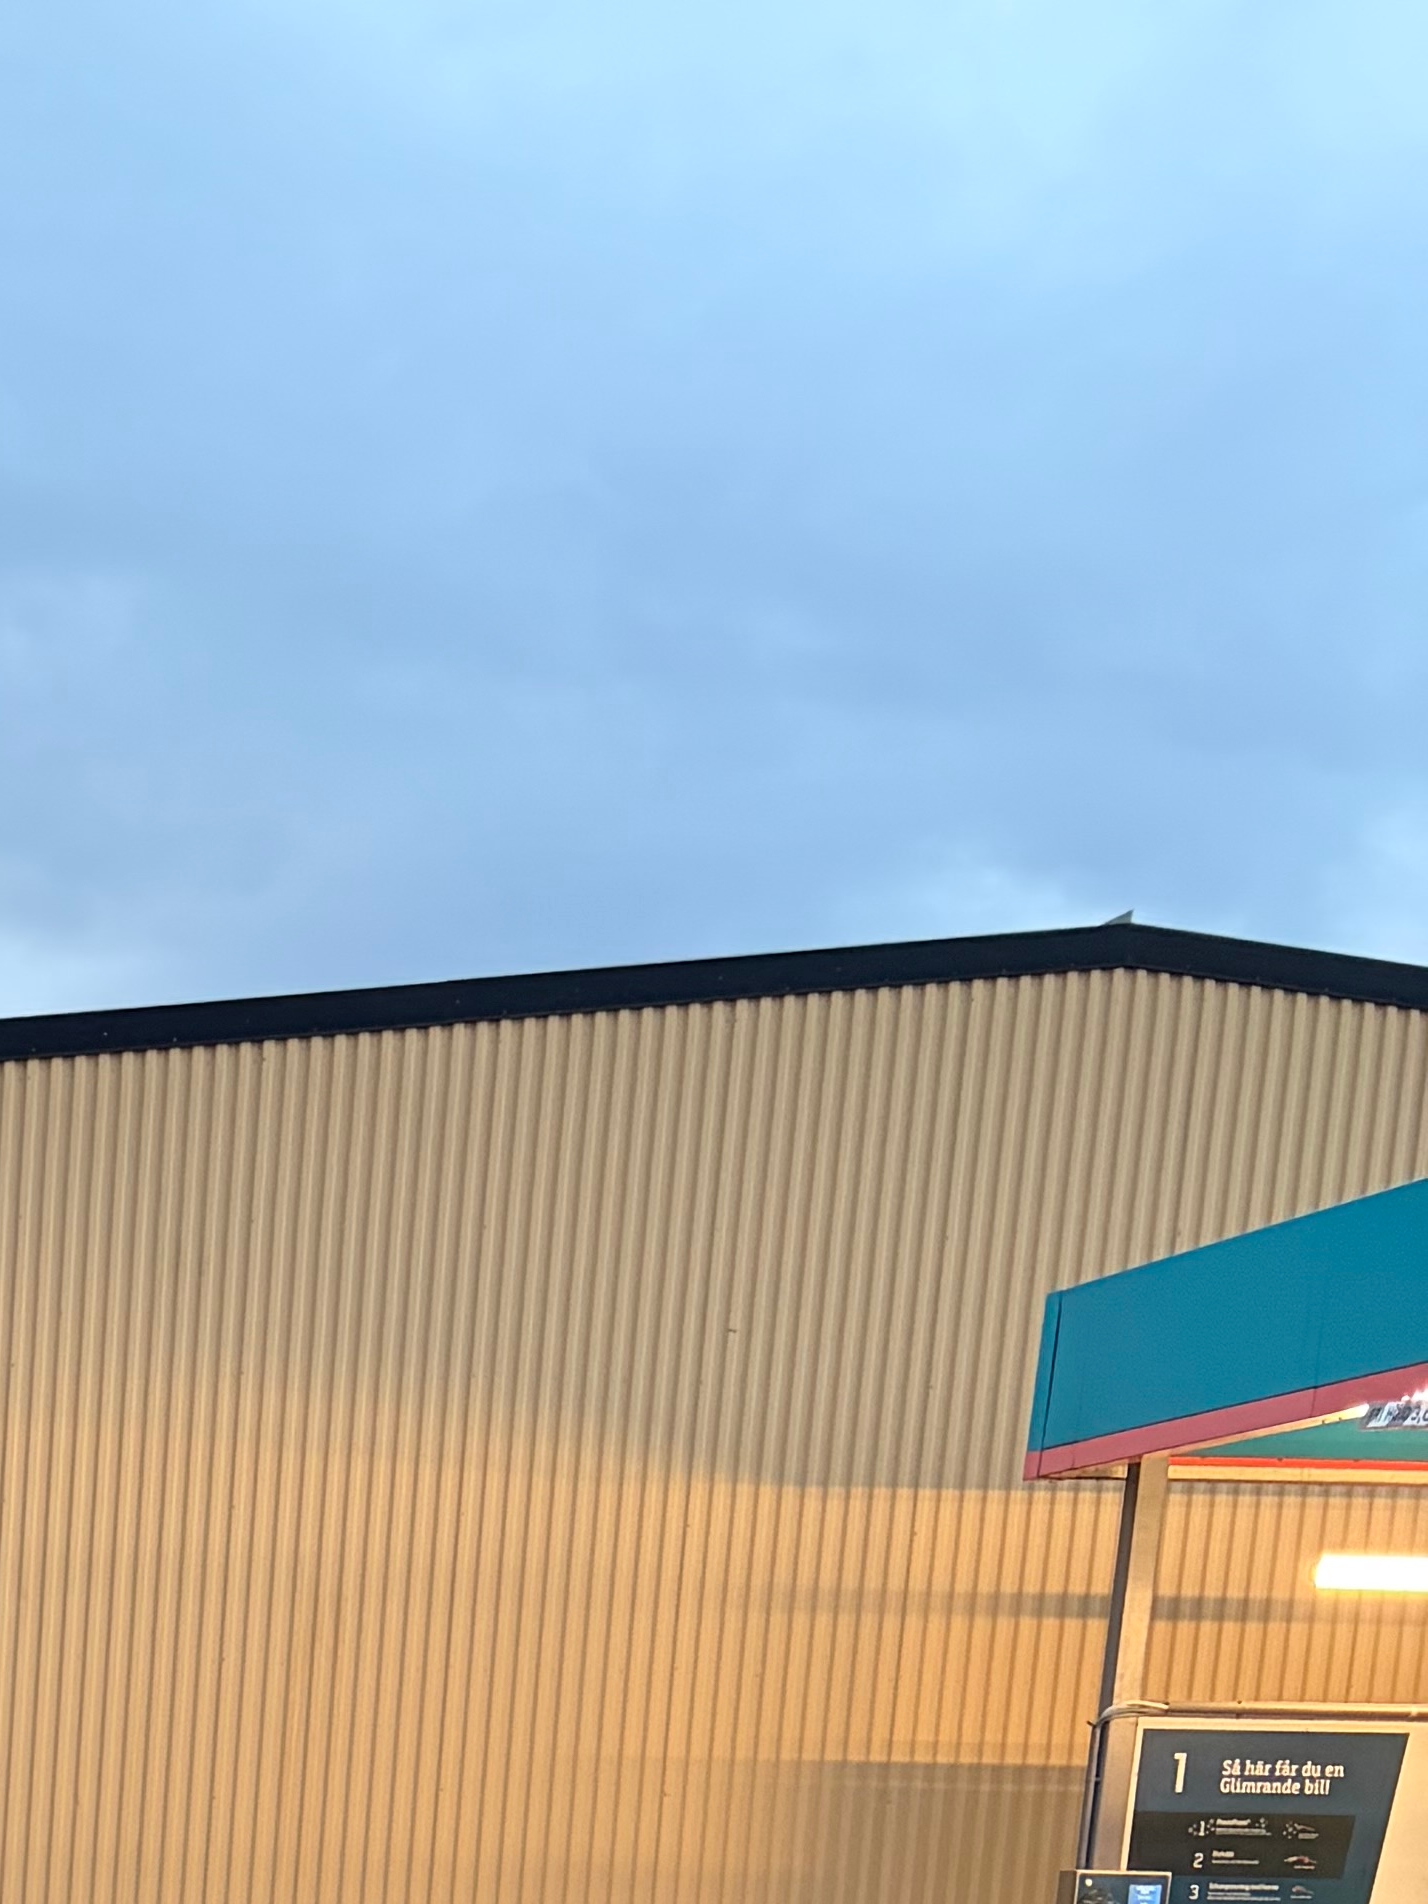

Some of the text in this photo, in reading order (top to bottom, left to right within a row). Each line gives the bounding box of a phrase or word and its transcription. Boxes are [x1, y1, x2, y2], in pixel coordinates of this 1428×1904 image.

[1174, 1752, 1187, 1793] 1
[1222, 1759, 1345, 1778] Så här får du en
[1220, 1777, 1300, 1795] Glimrande
[1193, 1852, 1204, 1869] 2
[1188, 1884, 1200, 1900] 3
